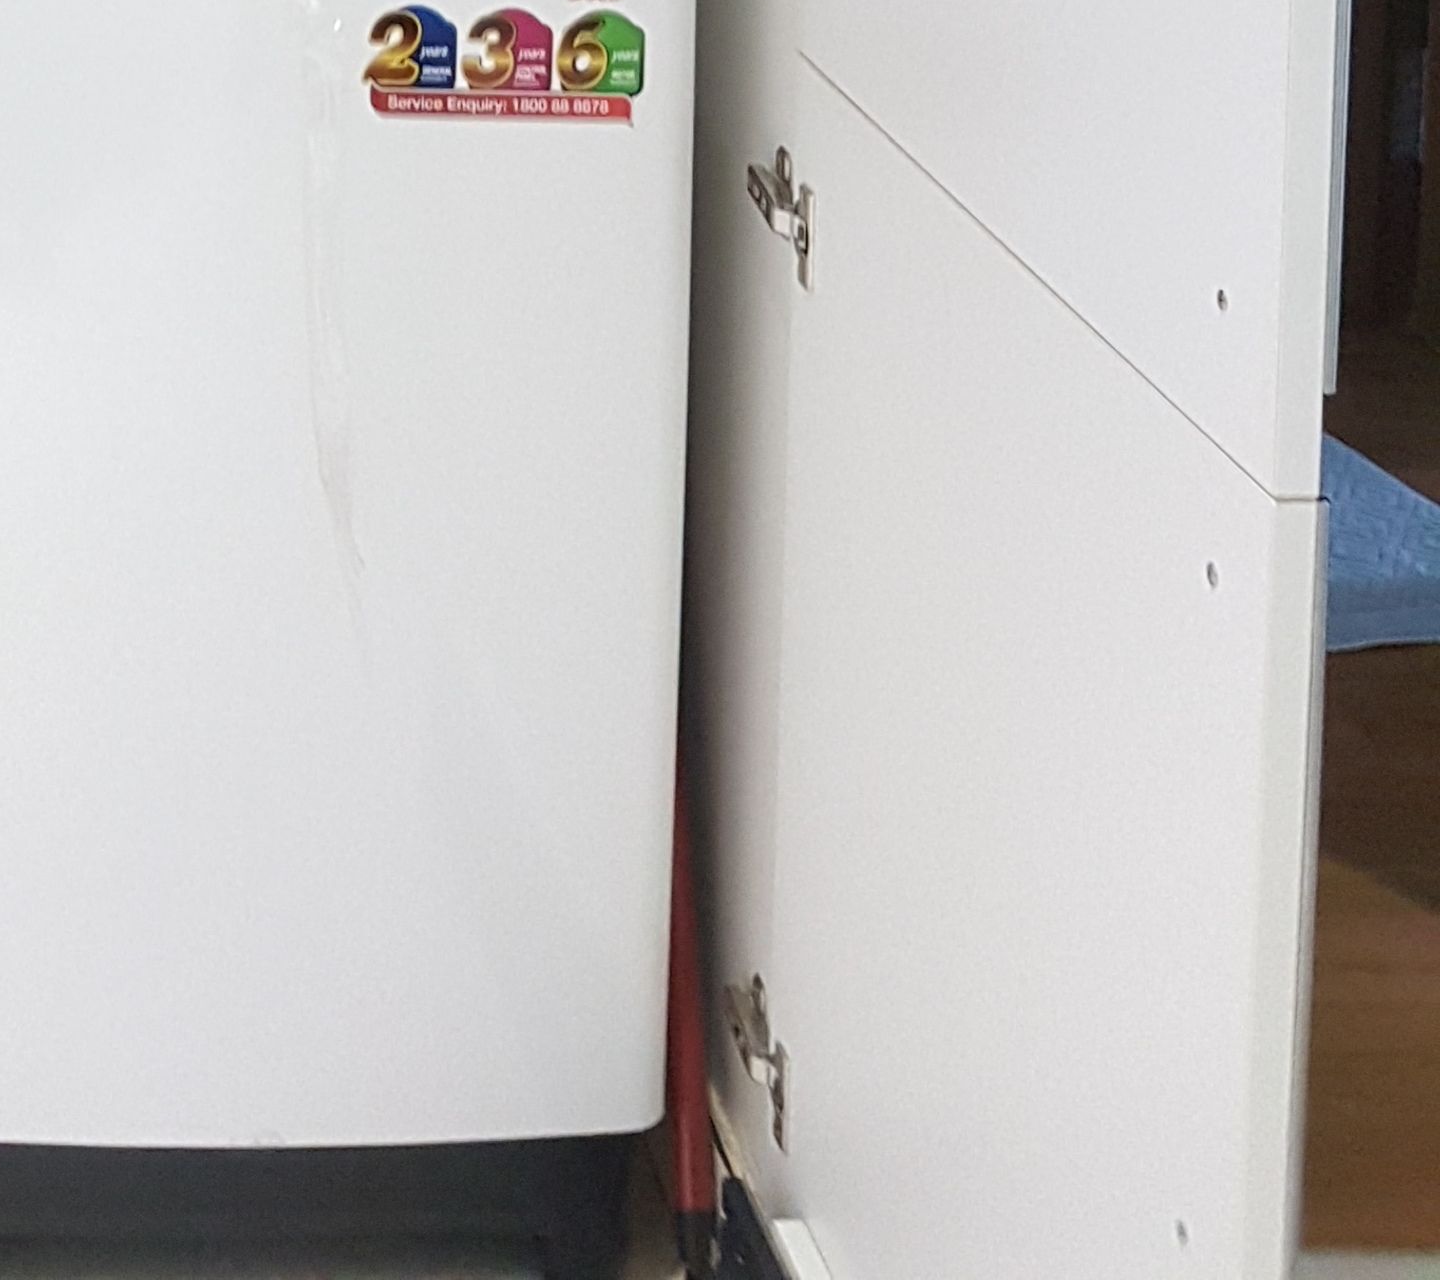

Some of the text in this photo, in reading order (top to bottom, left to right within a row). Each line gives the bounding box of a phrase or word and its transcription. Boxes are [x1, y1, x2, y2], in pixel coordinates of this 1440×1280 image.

[362, 10, 422, 88] 2
[461, 15, 516, 90] 3
[557, 18, 608, 91] 6
[388, 95, 444, 111] Service
[447, 95, 507, 116] Enquiry:
